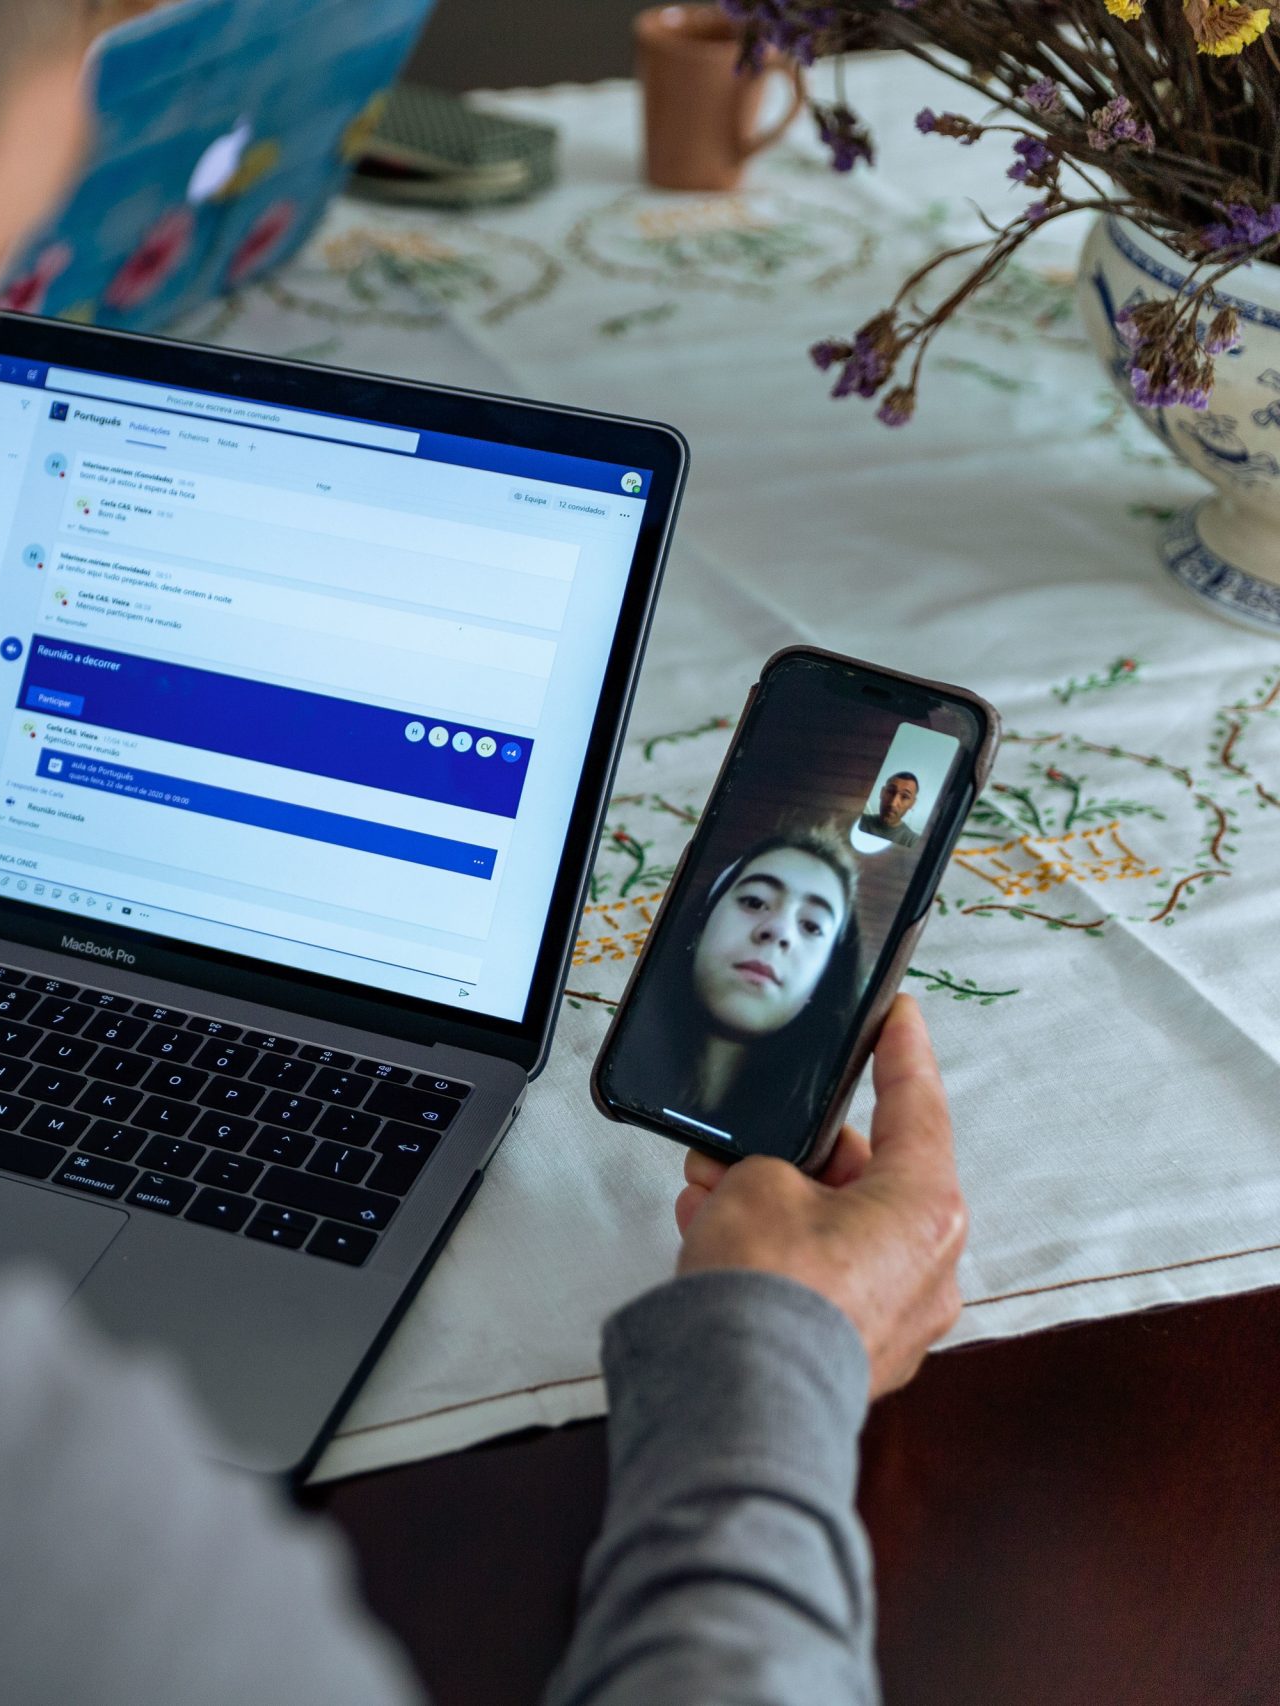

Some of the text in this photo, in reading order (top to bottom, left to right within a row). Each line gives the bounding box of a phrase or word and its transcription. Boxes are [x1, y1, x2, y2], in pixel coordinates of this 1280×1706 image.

[74, 410, 121, 427] Português
[129, 422, 171, 436] Publicações
[179, 431, 210, 443] Ficheiros
[218, 438, 238, 449] Notas
[316, 483, 332, 492] Hoje
[524, 495, 547, 505] Equipa
[568, 504, 605, 516] convidados
[38, 645, 74, 661] Reunião
[82, 655, 121, 671] decorrer
[38, 694, 71, 708] Participar
[44, 734, 120, 757] Agendou uma reunião
[71, 762, 87, 771] aula
[98, 766, 134, 781] Português
[148, 790, 164, 799] 2020
[28, 803, 85, 822] Reunião iniciada
[16, 858, 38, 869] ONDE
[61, 935, 136, 964] MacBook Pro
[6, 1032, 17, 1041] Y
[106, 1029, 117, 1038] 8
[58, 1047, 72, 1056] U
[161, 1044, 173, 1052] 9
[116, 1062, 123, 1070] I
[217, 1058, 228, 1066] 0
[169, 1076, 181, 1085] O
[103, 1095, 116, 1105] K
[160, 1110, 168, 1120] L
[48, 1119, 64, 1130] M
[218, 1126, 231, 1137] Ç
[63, 1172, 114, 1191] command
[136, 1193, 170, 1205] option
